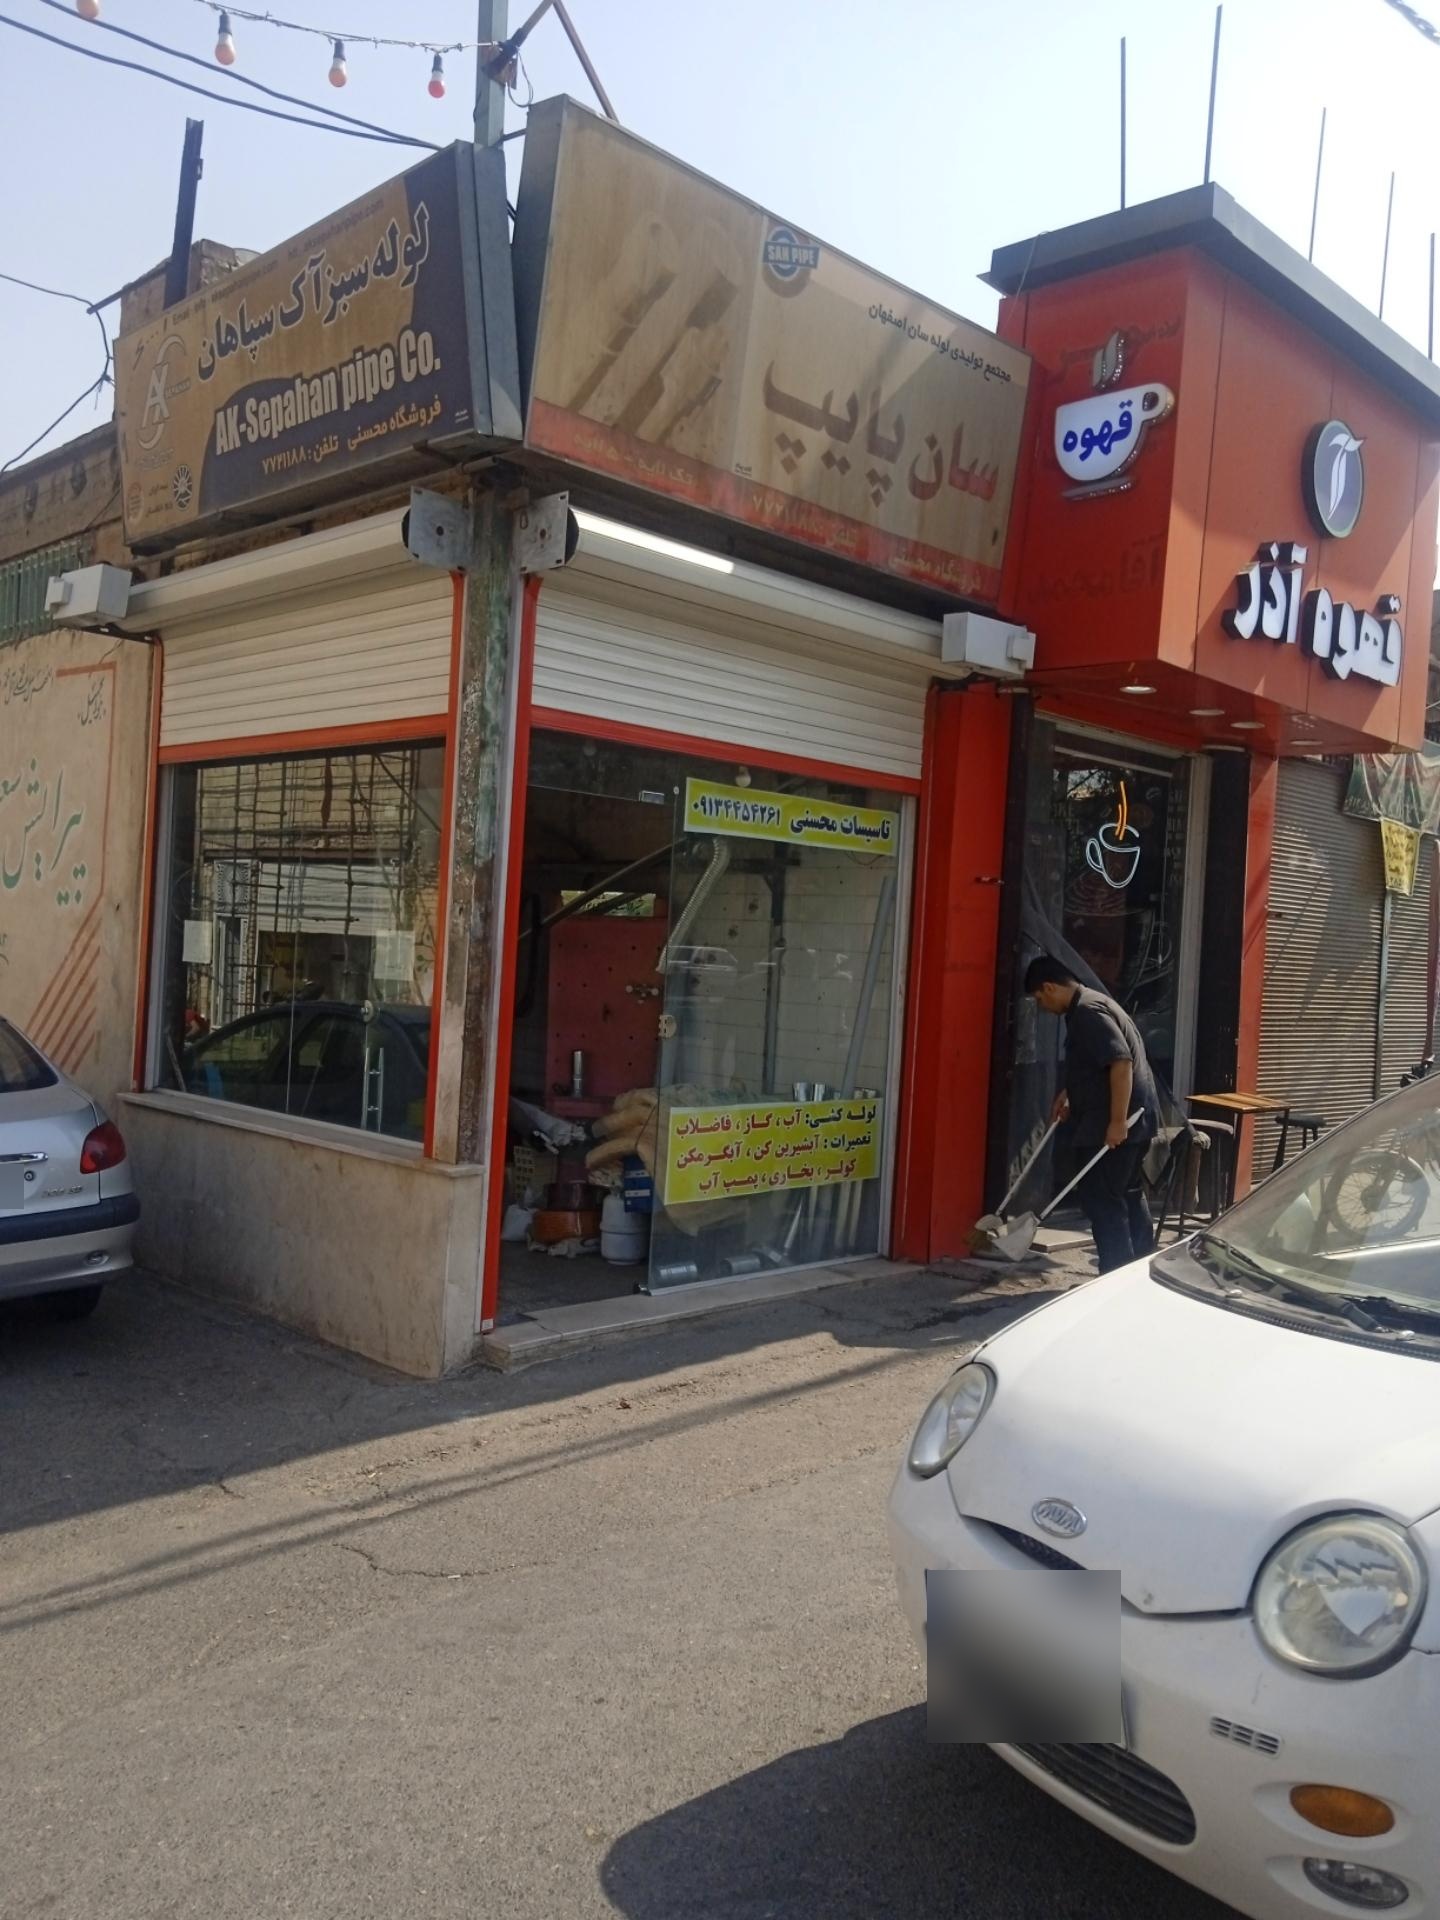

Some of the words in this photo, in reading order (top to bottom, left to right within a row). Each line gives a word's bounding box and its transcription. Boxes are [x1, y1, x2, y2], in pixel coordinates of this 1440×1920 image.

[372, 201, 429, 287] لوله
[791, 247, 815, 266] PIPE
[279, 249, 326, 330] آک
[322, 256, 369, 326] سبز
[868, 303, 907, 329] اصفهان
[198, 299, 274, 381] سپاهان
[907, 322, 928, 340] سان
[951, 348, 983, 370] تولیدی
[984, 362, 1011, 384] مجتمع
[216, 371, 338, 455] AK-Sepahan
[341, 347, 395, 412] pipe
[399, 329, 441, 382] Co.
[390, 394, 441, 431] فروشگاه
[347, 422, 388, 450] محسنی
[763, 360, 905, 508] پایپ
[1062, 400, 1133, 461] قهوه
[908, 421, 999, 502] سان
[1230, 541, 1308, 643] آذر
[1307, 588, 1401, 687] قهوه
[790, 810, 837, 833] محسنی
[841, 815, 890, 843] تاسیسات
[676, 1114, 732, 1136] فاضلاب
[846, 1104, 877, 1121] لوله
[774, 1134, 820, 1158] آبشیرین
[698, 1172, 720, 1194] آب
[723, 1173, 758, 1194] پمپ
